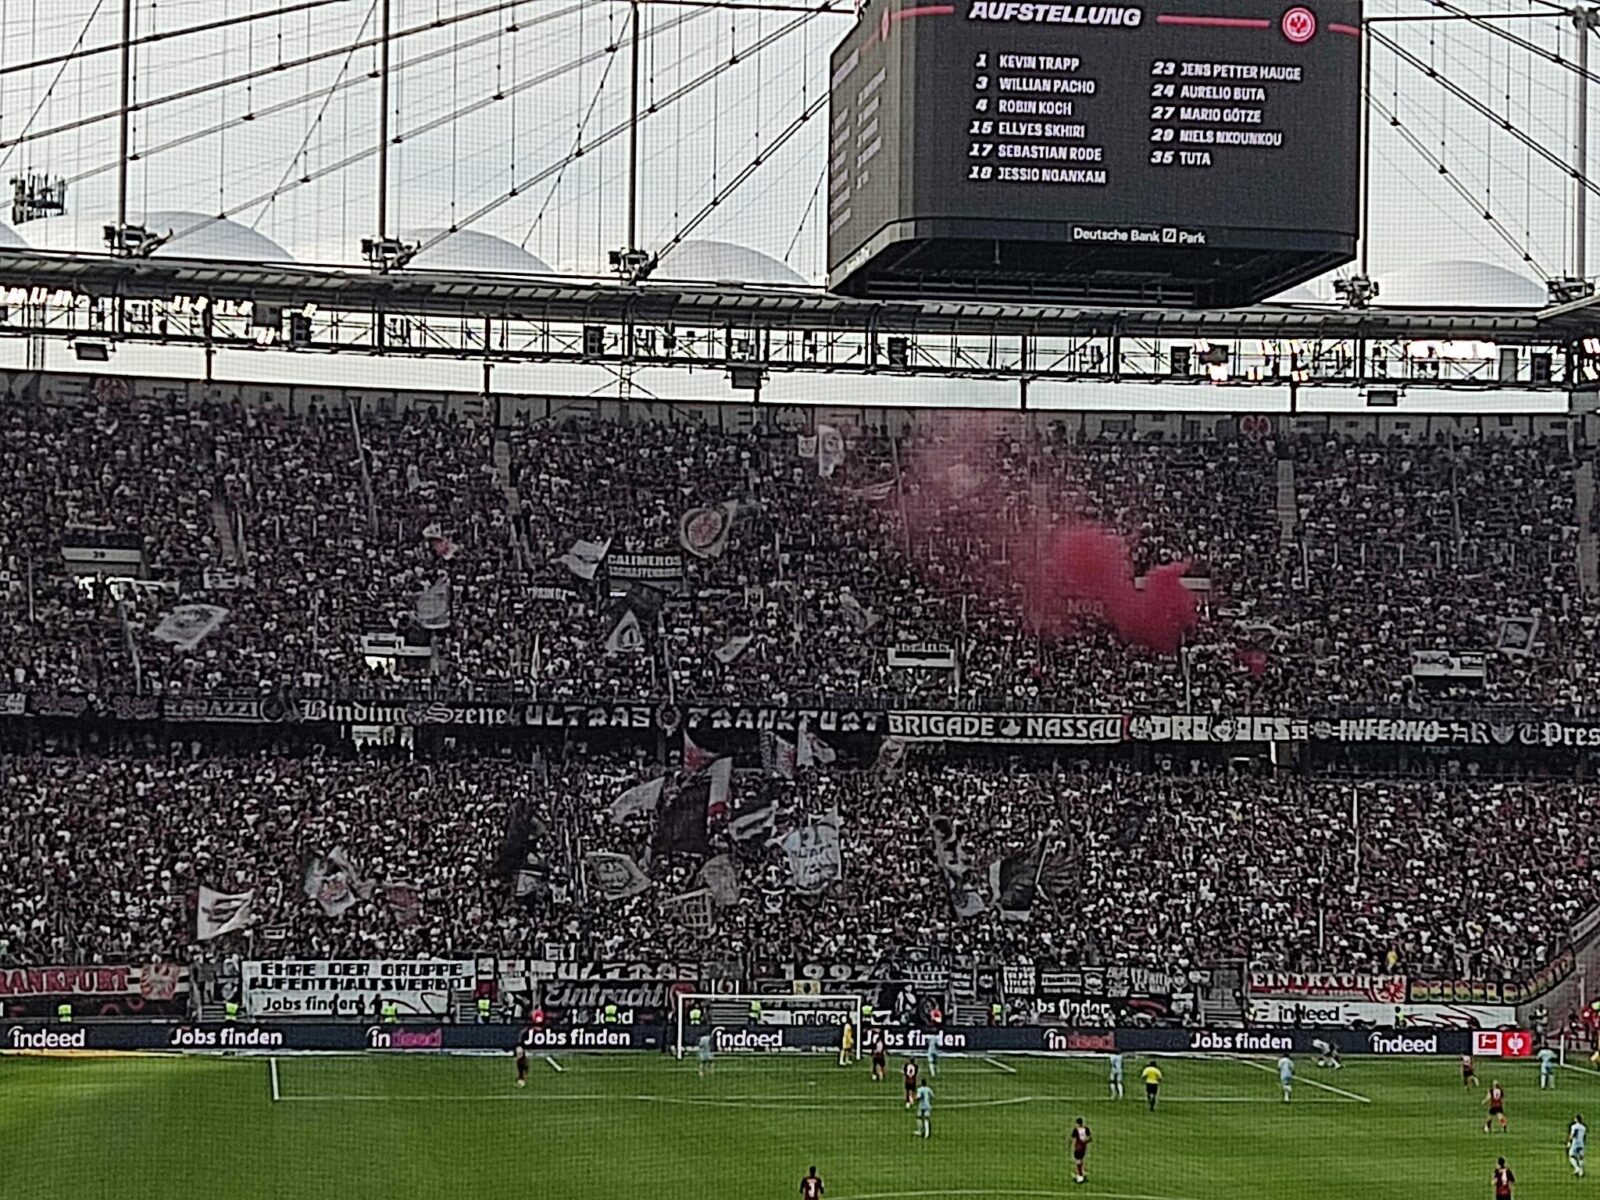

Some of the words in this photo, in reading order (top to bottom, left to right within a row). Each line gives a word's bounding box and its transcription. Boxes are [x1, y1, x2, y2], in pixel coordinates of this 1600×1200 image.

[968, 1, 1142, 26] AUFSTELLUNG
[976, 54, 986, 67] 1
[1000, 55, 1036, 69] KEVIN
[1039, 57, 1080, 71] TRAPP
[1152, 62, 1175, 75] 23
[1181, 63, 1211, 77] JENS
[1213, 64, 1257, 79] PETTER
[1260, 66, 1301, 81] HAUGE
[976, 76, 988, 89] 3
[999, 77, 1050, 92] WILLIAN
[1053, 80, 1095, 94] PACHO
[1152, 84, 1175, 97] 24
[1181, 85, 1231, 99] AURELIO
[1233, 87, 1265, 101] BUTA
[976, 99, 988, 111] 4
[999, 100, 1036, 113] ROBIN
[1038, 102, 1072, 115] KOCH
[1151, 106, 1175, 119] 27
[1180, 107, 1221, 121] MARIO
[970, 121, 993, 134] 15
[1045, 124, 1085, 138] SKHIRI
[1180, 130, 1214, 143] NIELS
[969, 144, 993, 156] 17
[998, 145, 1067, 160] SEBASTIAN
[1069, 148, 1102, 161] RODE
[1151, 151, 1174, 163] 35
[1180, 152, 1211, 165] TUTA
[969, 166, 992, 179] 18
[1074, 227, 1128, 241] Deutsche
[1131, 230, 1160, 242] Bank
[1179, 232, 1205, 244] Park
[300, 700, 408, 725] Binding
[425, 702, 507, 727] Szene
[526, 705, 649, 727] ULTRAS
[889, 715, 994, 736] BRIGADE
[1027, 719, 1121, 738] NASSAU
[328, 963, 369, 976] DER
[263, 997, 300, 1011] Jobs
[9, 1026, 85, 1047] indeed
[171, 1028, 216, 1045] Jobs
[220, 1028, 283, 1045] finden
[524, 1029, 567, 1045] Jobs
[570, 1028, 631, 1046] finden
[711, 1027, 783, 1047] indeed
[1190, 1033, 1232, 1049] Jobs
[1235, 1033, 1292, 1049] finden
[1368, 1032, 1437, 1053] indeed
